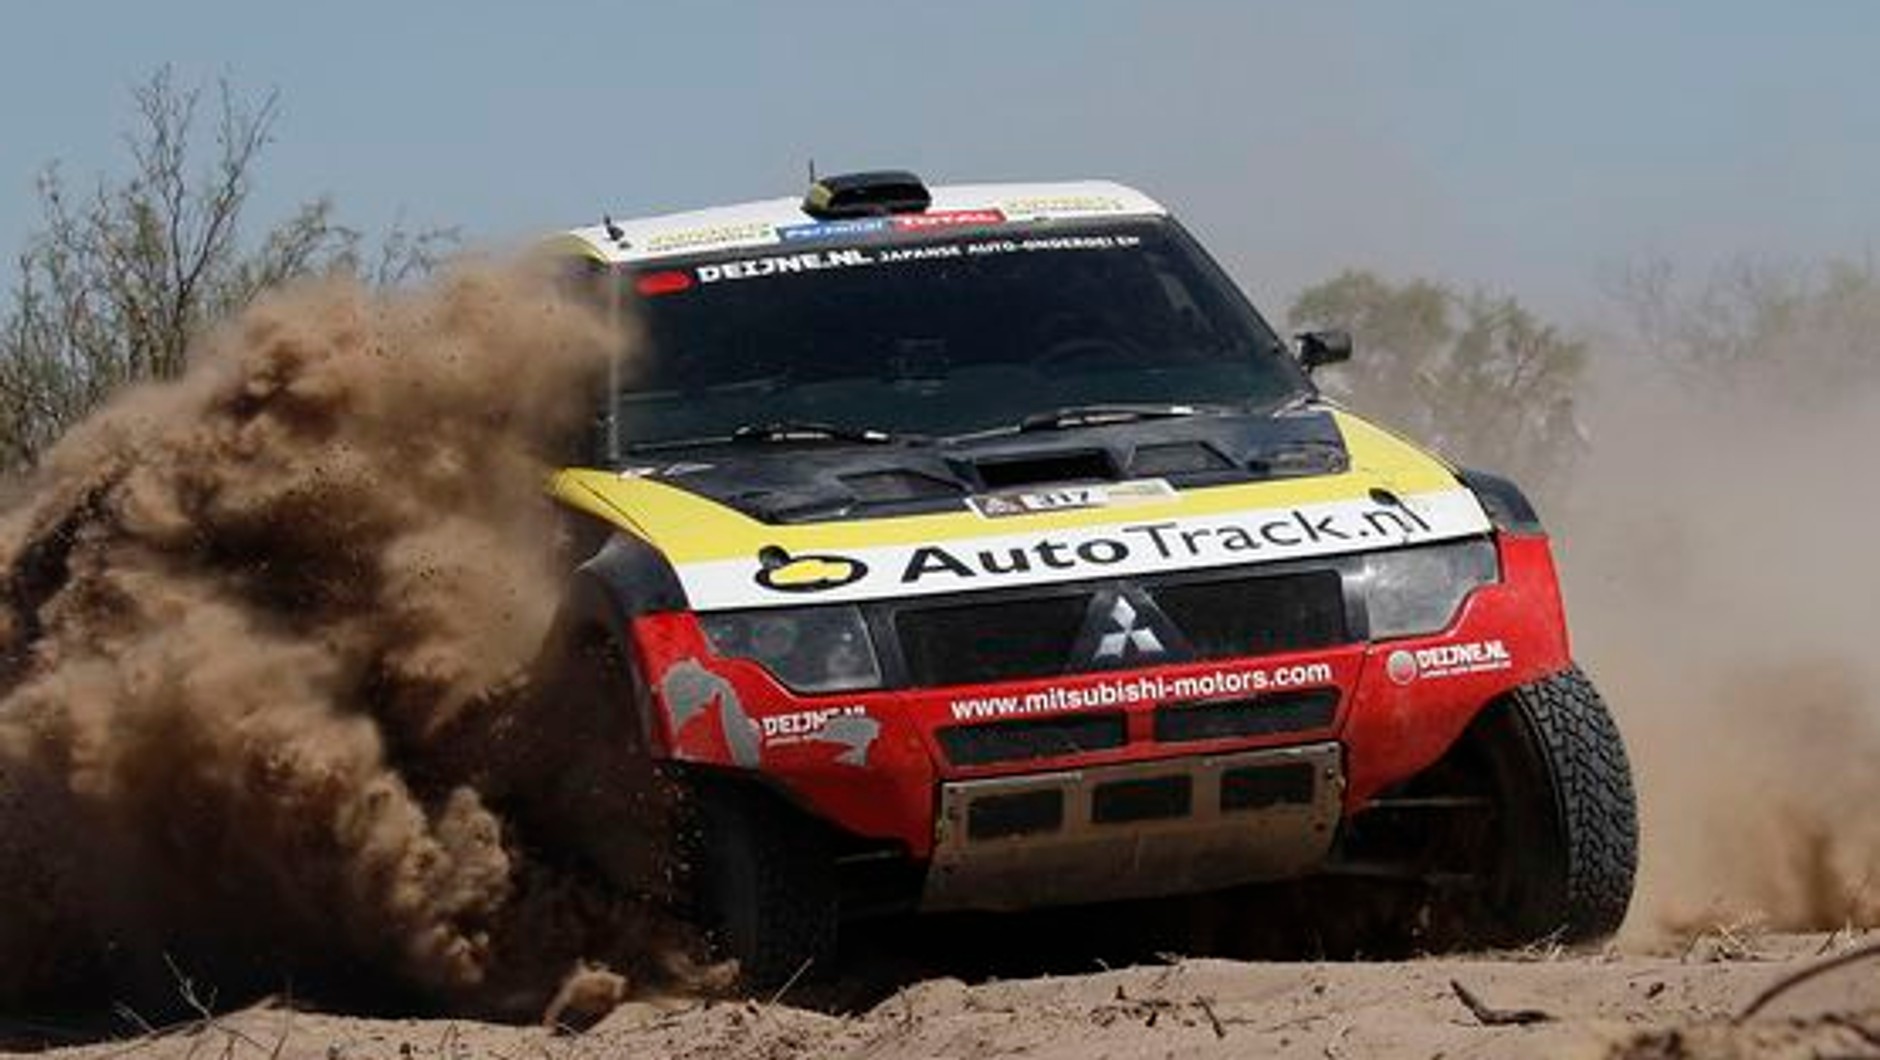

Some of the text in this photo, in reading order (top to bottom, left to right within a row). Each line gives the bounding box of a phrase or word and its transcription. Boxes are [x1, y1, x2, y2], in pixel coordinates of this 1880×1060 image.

[697, 249, 872, 283] DEIJNE.NL
[880, 246, 962, 263] JAPANSE
[901, 500, 1431, 583] AutoTrack.nl
[1416, 640, 1510, 669] DEIJNE.NL
[951, 661, 1332, 720] www.mitsubishi-motors.com
